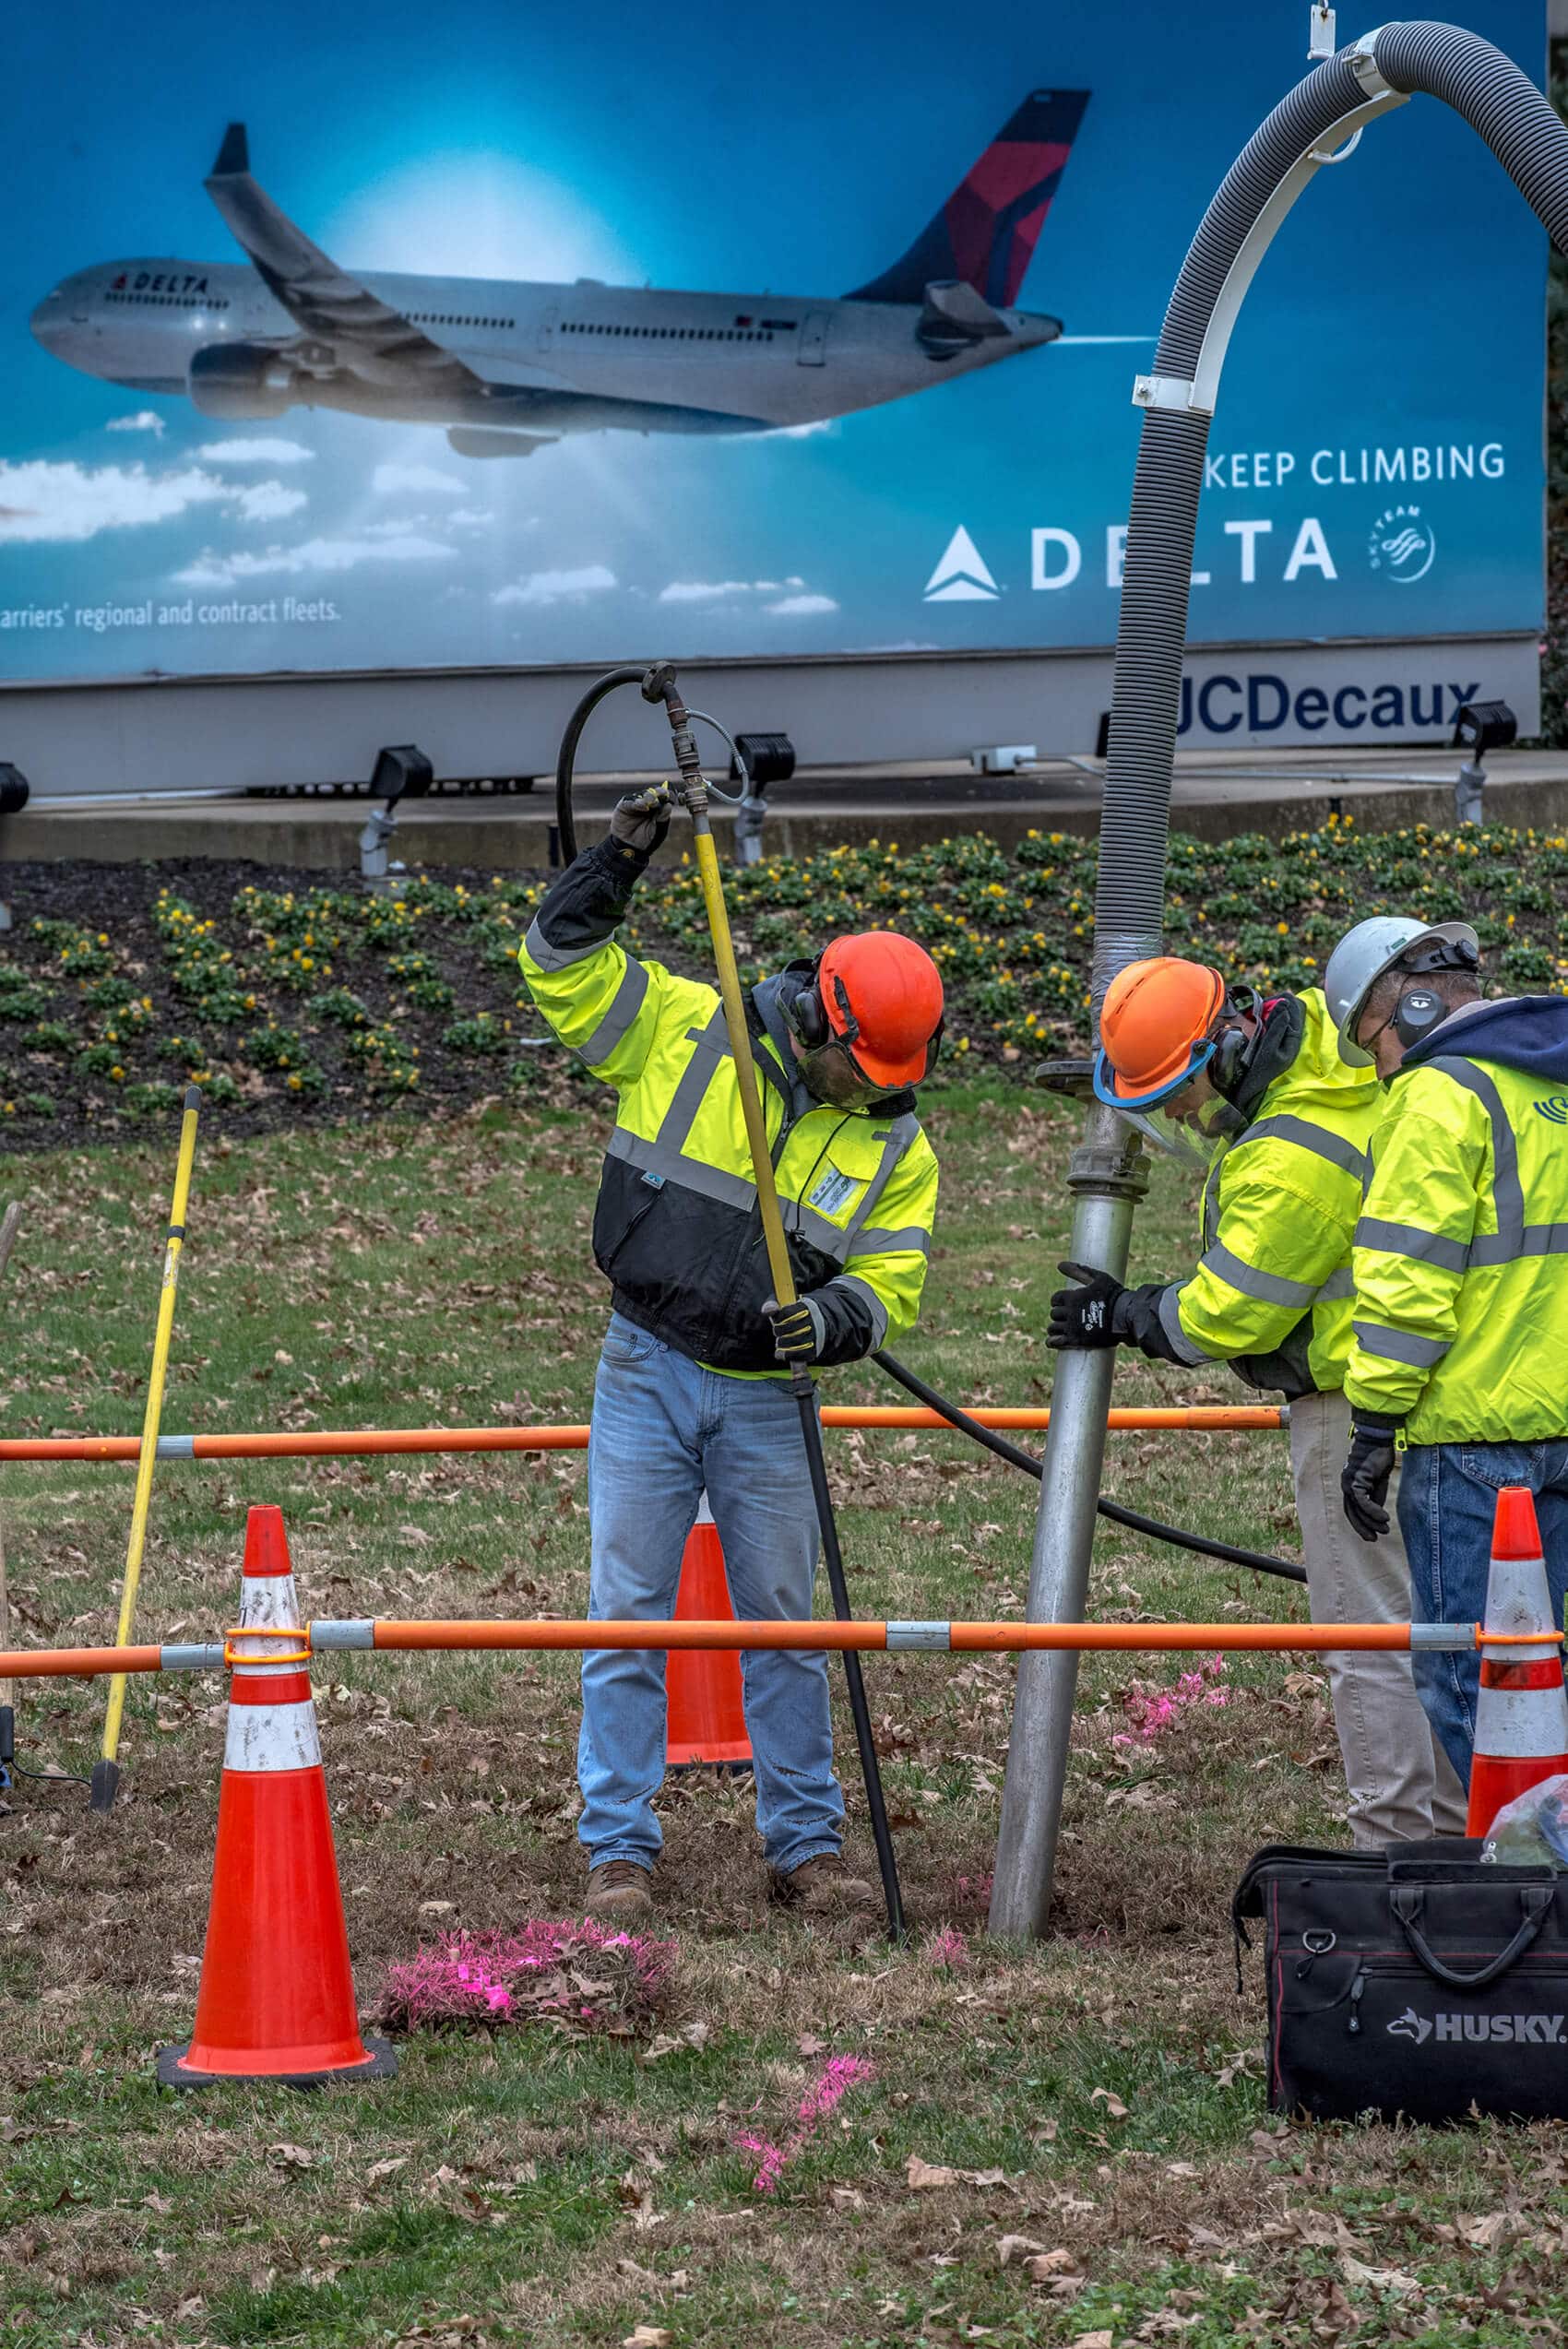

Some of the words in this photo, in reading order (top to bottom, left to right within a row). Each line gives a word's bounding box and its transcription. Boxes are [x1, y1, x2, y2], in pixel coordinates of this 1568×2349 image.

[133, 271, 208, 294] DELTA
[1204, 452, 1295, 489] KEEP
[1311, 443, 1505, 485] CLIMBING
[1031, 517, 1338, 591] DETA
[75, 599, 152, 634] regional
[158, 599, 192, 626] and
[197, 599, 277, 624] contract
[282, 597, 341, 622] fleets.
[1176, 674, 1481, 736] JCDecaux
